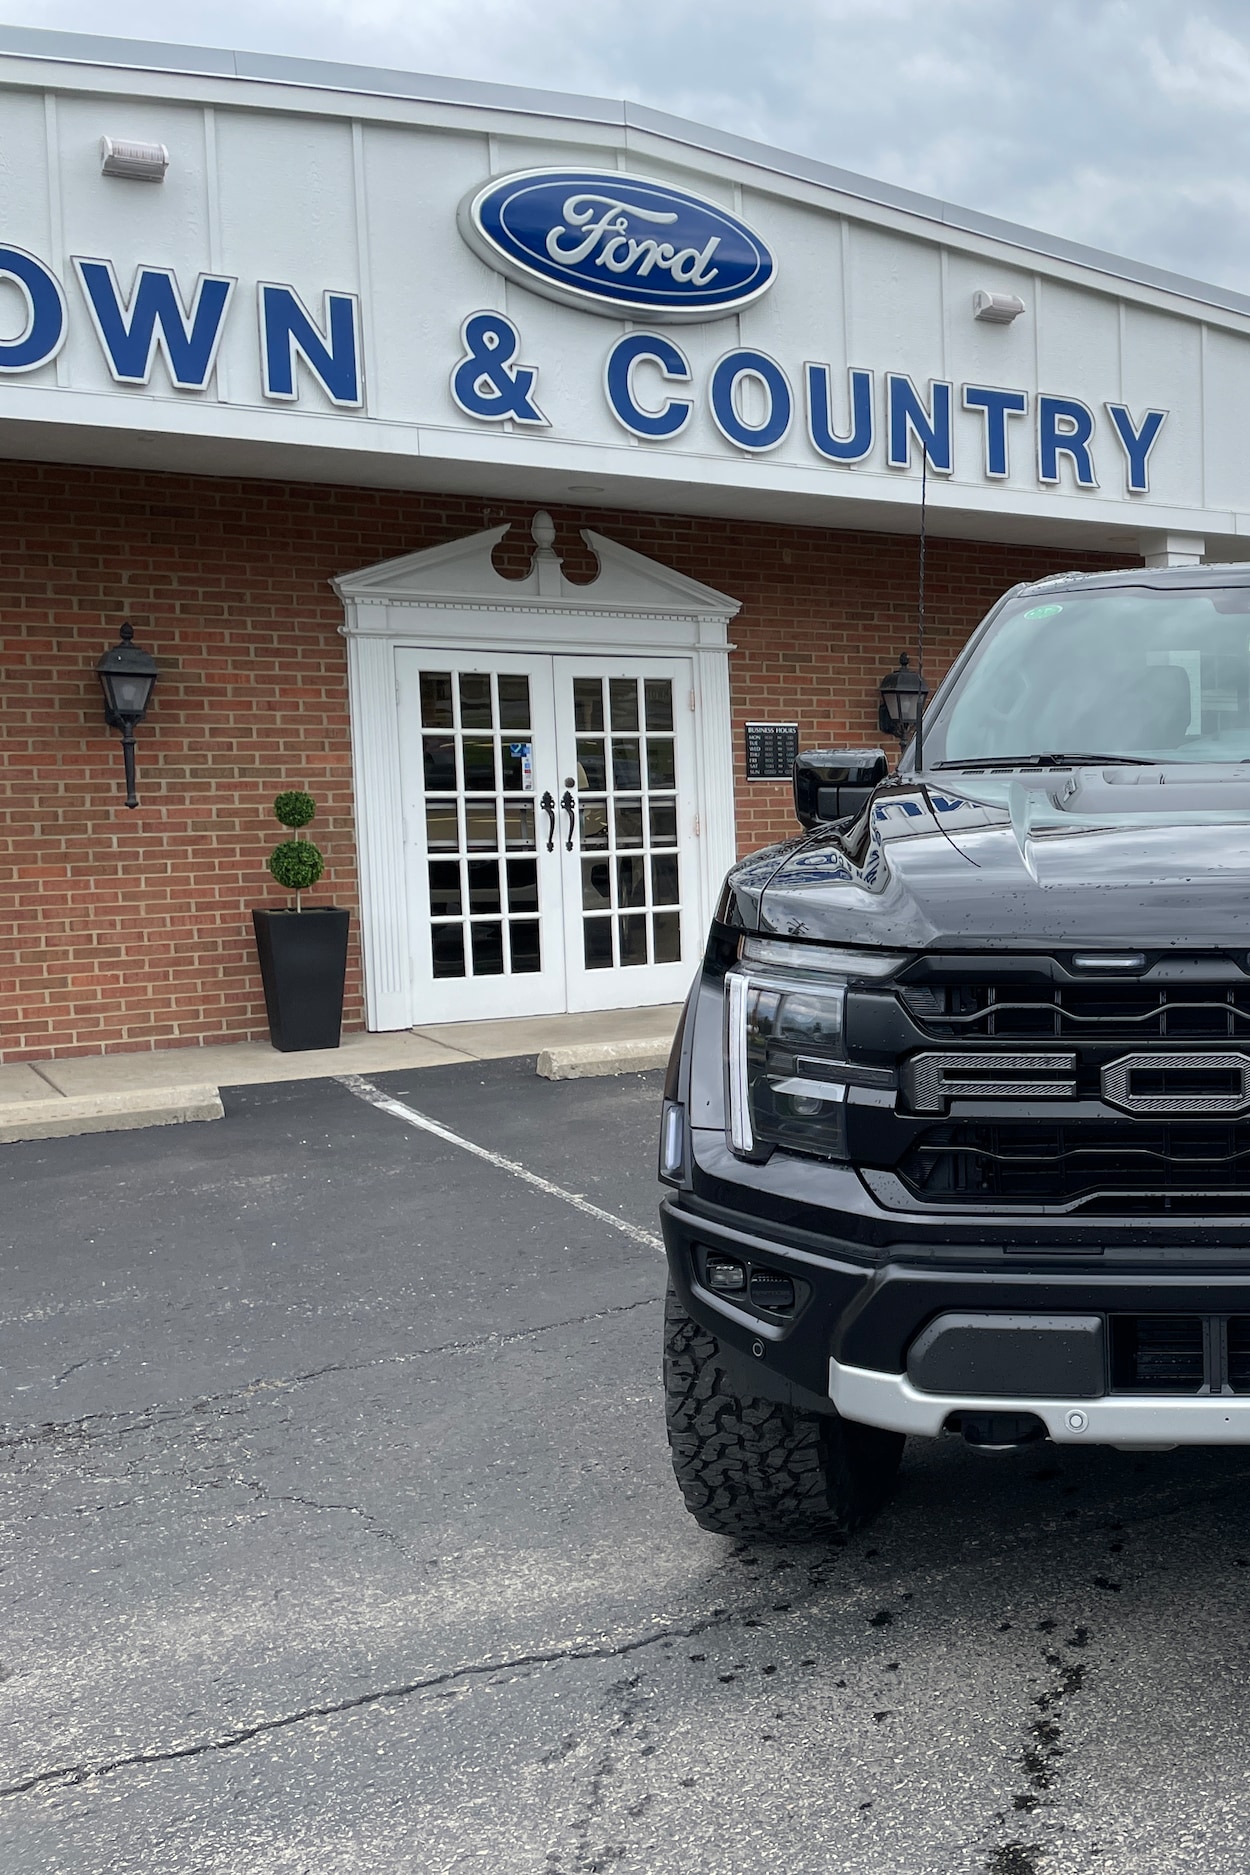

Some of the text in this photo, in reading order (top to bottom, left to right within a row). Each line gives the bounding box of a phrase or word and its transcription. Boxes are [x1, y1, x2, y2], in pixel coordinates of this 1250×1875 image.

[545, 193, 722, 287] Ford
[450, 308, 553, 428] &
[602, 329, 1171, 494] COUNTRY
